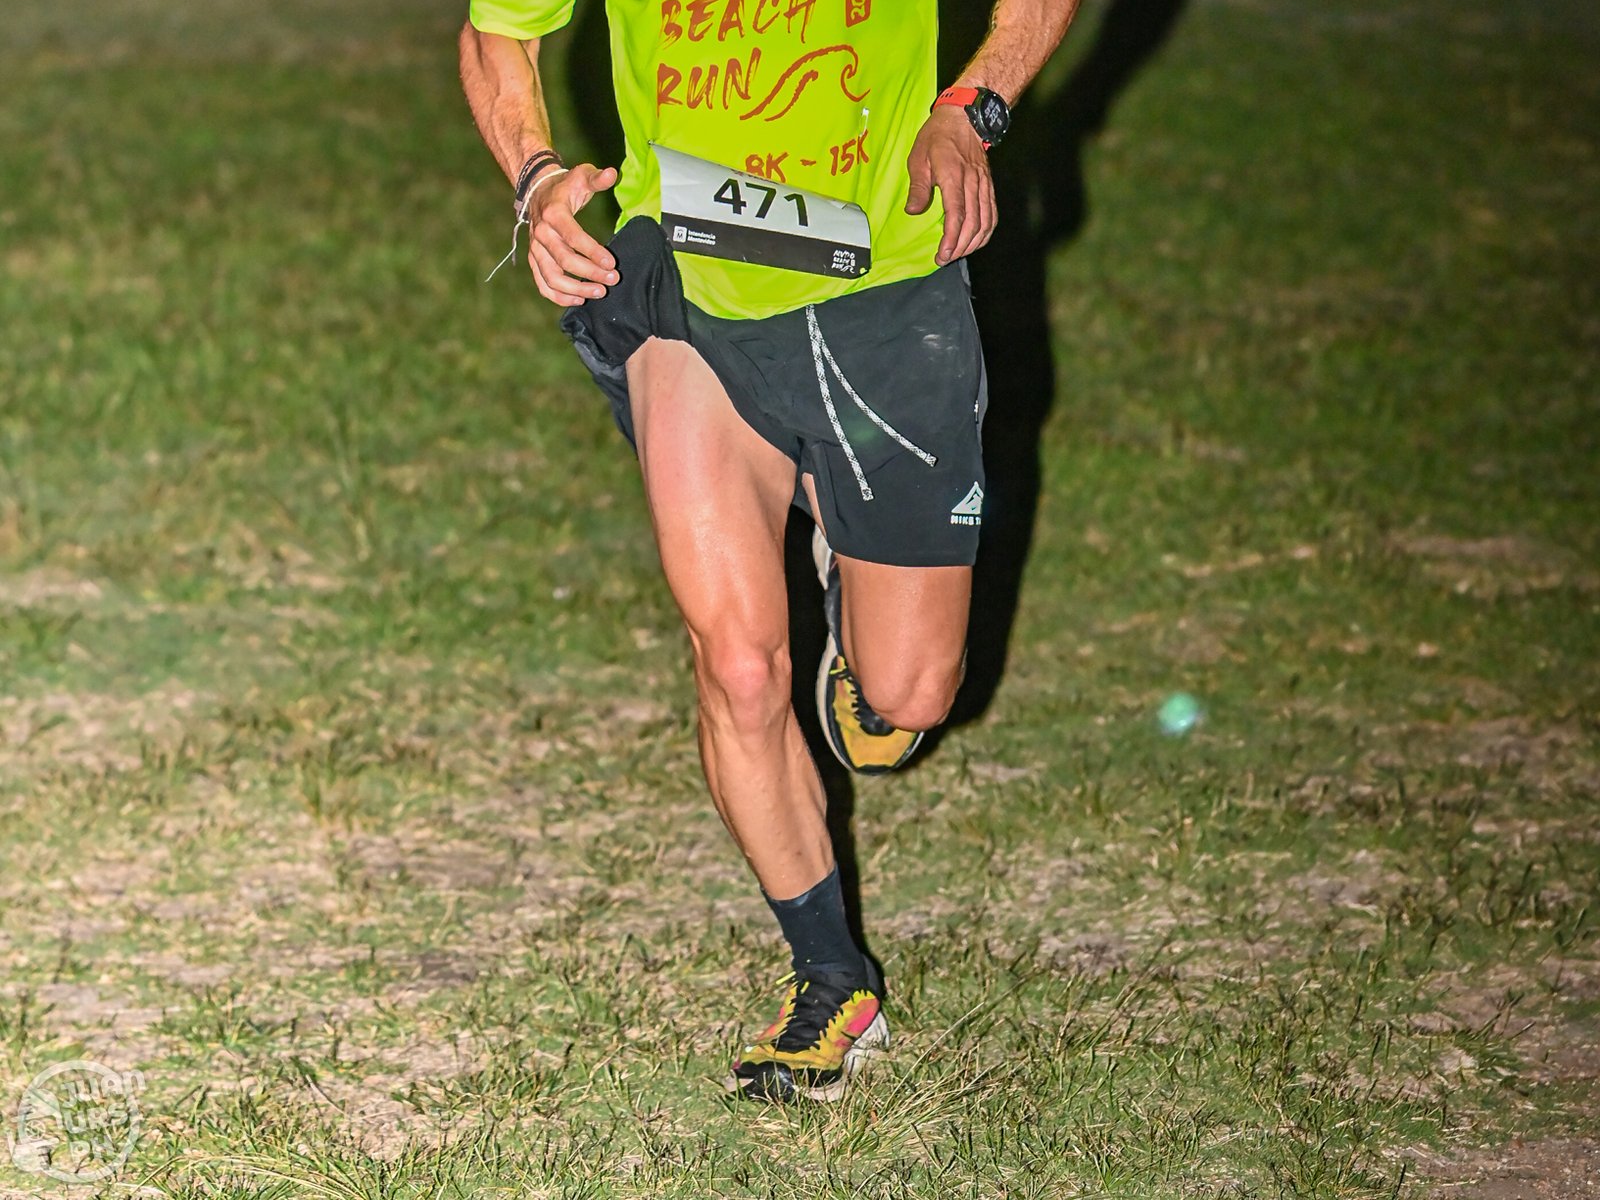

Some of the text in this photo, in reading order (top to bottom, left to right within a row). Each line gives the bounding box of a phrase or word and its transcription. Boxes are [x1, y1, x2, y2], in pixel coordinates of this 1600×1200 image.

[657, 47, 762, 118] RUN
[830, 130, 869, 176] 15K
[713, 178, 809, 227] 471
